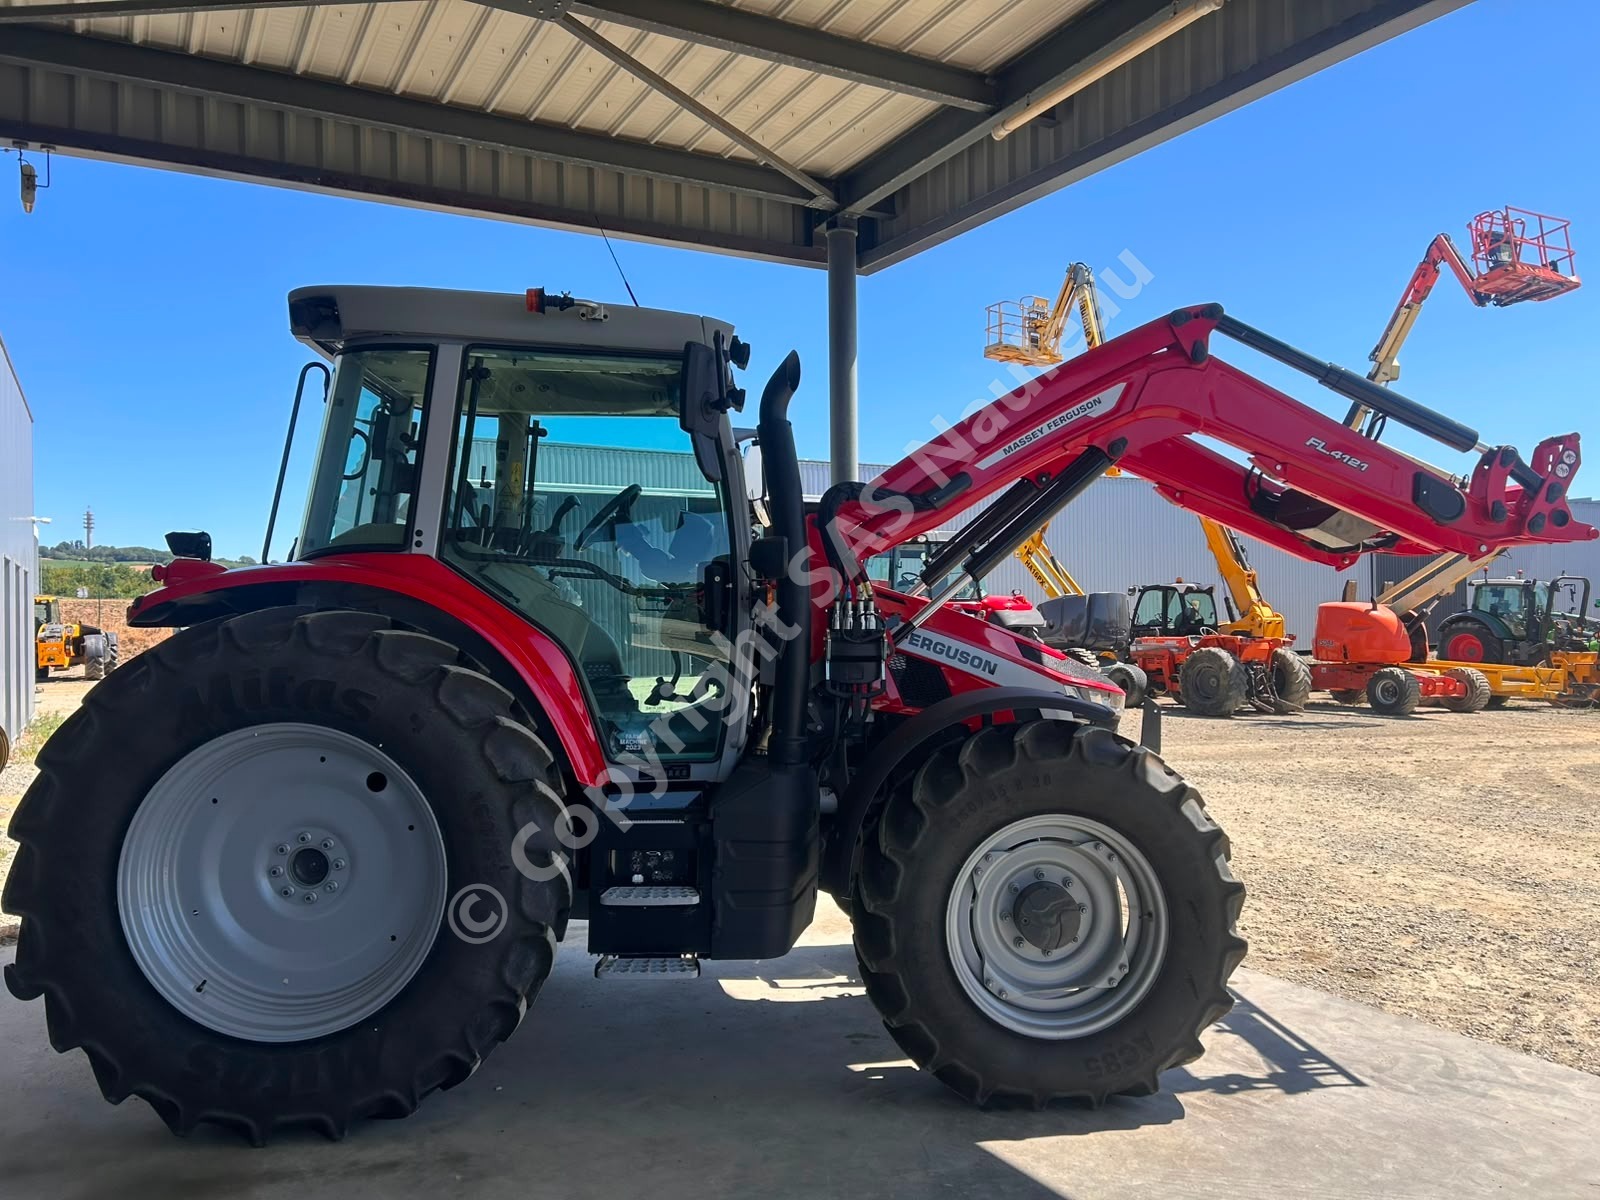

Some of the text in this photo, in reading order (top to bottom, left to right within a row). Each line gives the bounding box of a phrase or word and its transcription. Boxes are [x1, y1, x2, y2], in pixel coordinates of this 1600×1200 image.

[1003, 397, 1102, 456] MASSEY FERGUSON
[1024, 559, 1046, 587] HA16PX
[904, 632, 999, 676] ERGUSON
